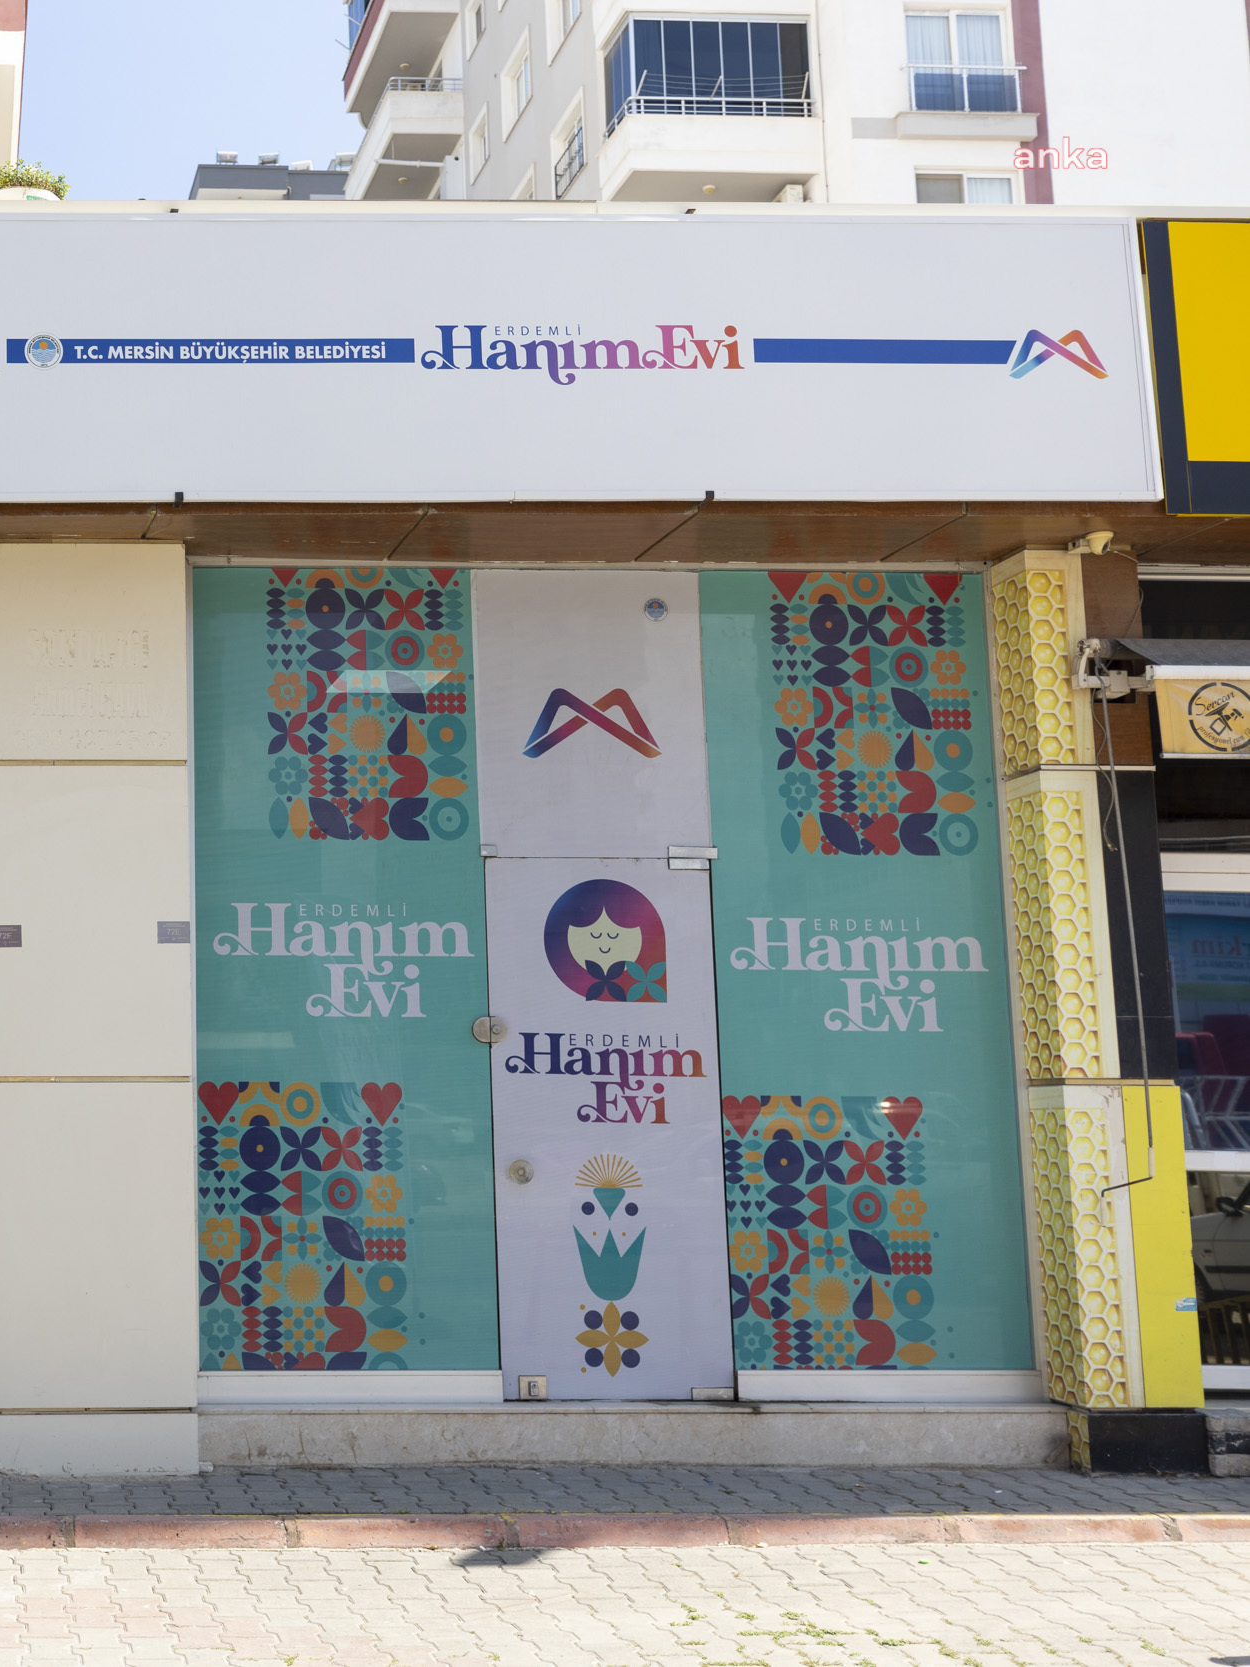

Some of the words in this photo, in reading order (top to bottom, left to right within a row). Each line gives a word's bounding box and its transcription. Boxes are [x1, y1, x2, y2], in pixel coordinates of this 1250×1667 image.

[494, 324, 581, 336] ERDEMLİ
[74, 345, 104, 360] T.C.
[107, 341, 174, 360] MERSİN
[179, 341, 290, 363] BÜYÜKŞEHİR
[294, 341, 386, 359] BELEDİYESİ
[1194, 691, 1236, 717] Sercan
[299, 903, 407, 917] ERDEMLİ
[813, 917, 920, 932] ERDEMLİ
[213, 903, 476, 975] Hanım
[730, 917, 989, 990] Hanım
[306, 963, 427, 1017] Evi
[824, 978, 944, 1032] Evi
[569, 1033, 680, 1048] ERDEMLİ
[505, 1032, 708, 1091] Hanım
[577, 1081, 670, 1124] Evi
